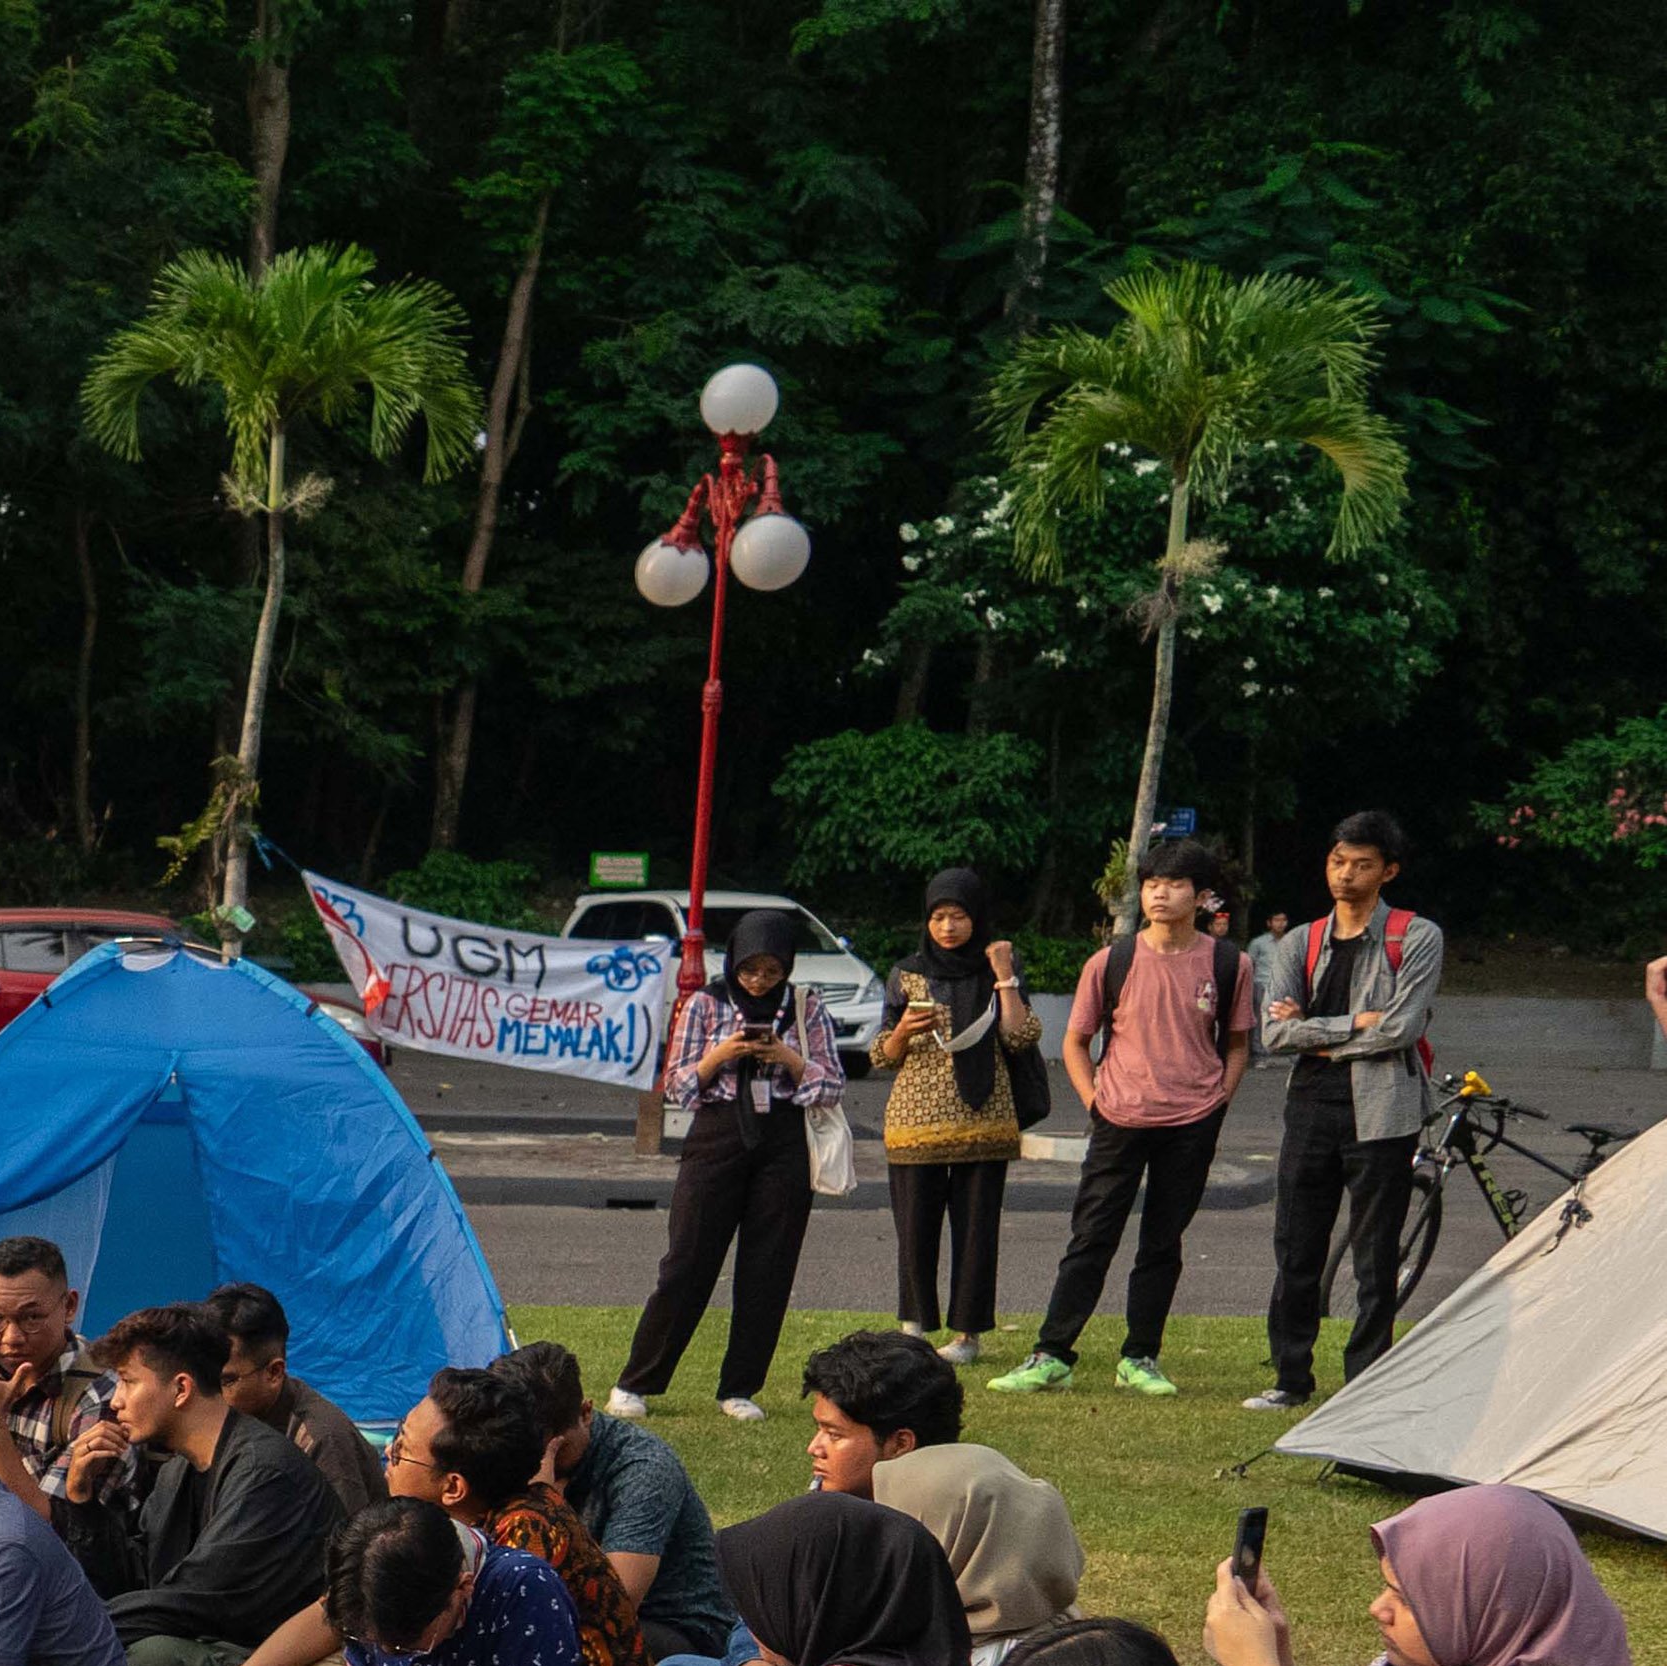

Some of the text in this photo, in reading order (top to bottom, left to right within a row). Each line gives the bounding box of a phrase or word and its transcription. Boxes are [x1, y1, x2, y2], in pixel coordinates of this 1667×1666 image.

[402, 917, 546, 988] UGM
[381, 963, 604, 1048] ERSITAS GEMAR
